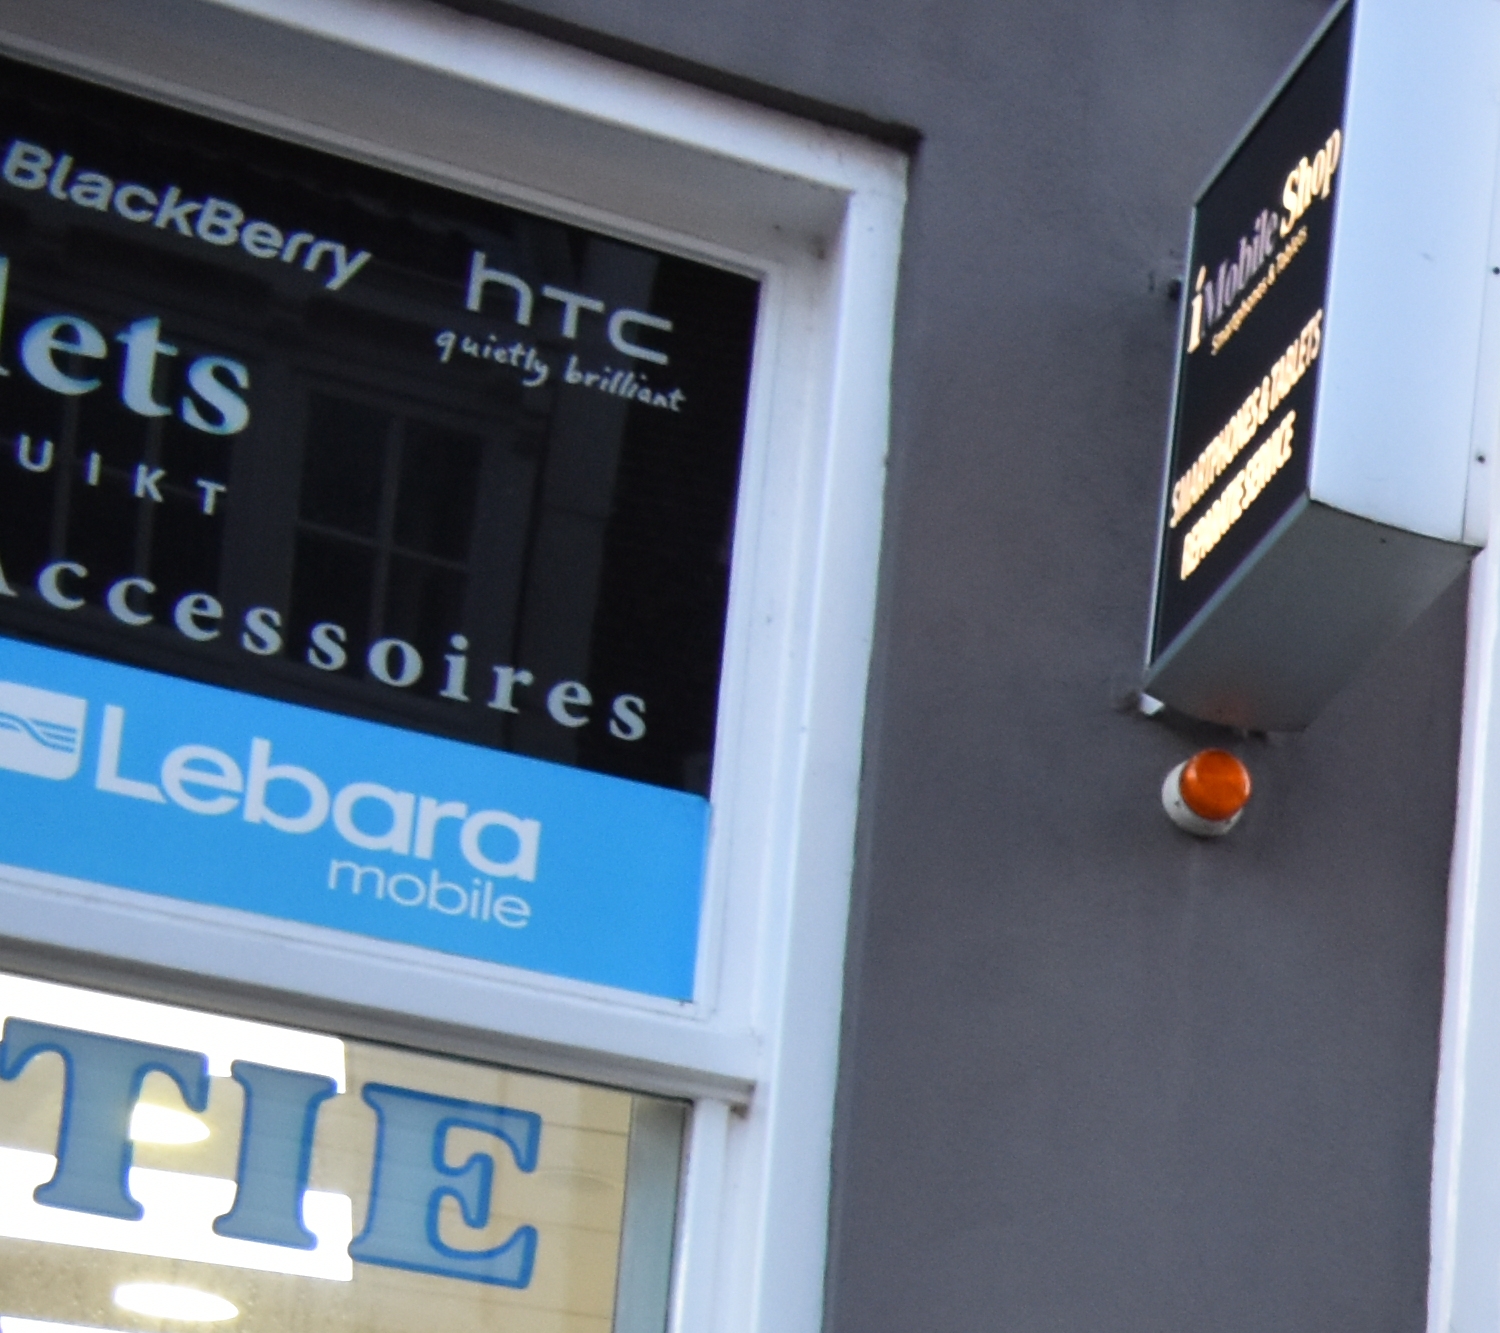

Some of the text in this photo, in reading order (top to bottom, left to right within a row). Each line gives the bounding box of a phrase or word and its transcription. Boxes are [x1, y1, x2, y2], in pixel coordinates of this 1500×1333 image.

[2, 140, 372, 292] BlackBerry
[1280, 127, 1342, 238] Shop
[436, 328, 687, 416] quietly brilliant
[0, 547, 648, 743] ccessoires
[95, 703, 542, 883] Lebara
[327, 858, 532, 930] mobile
[0, 1015, 543, 1290] TIE
